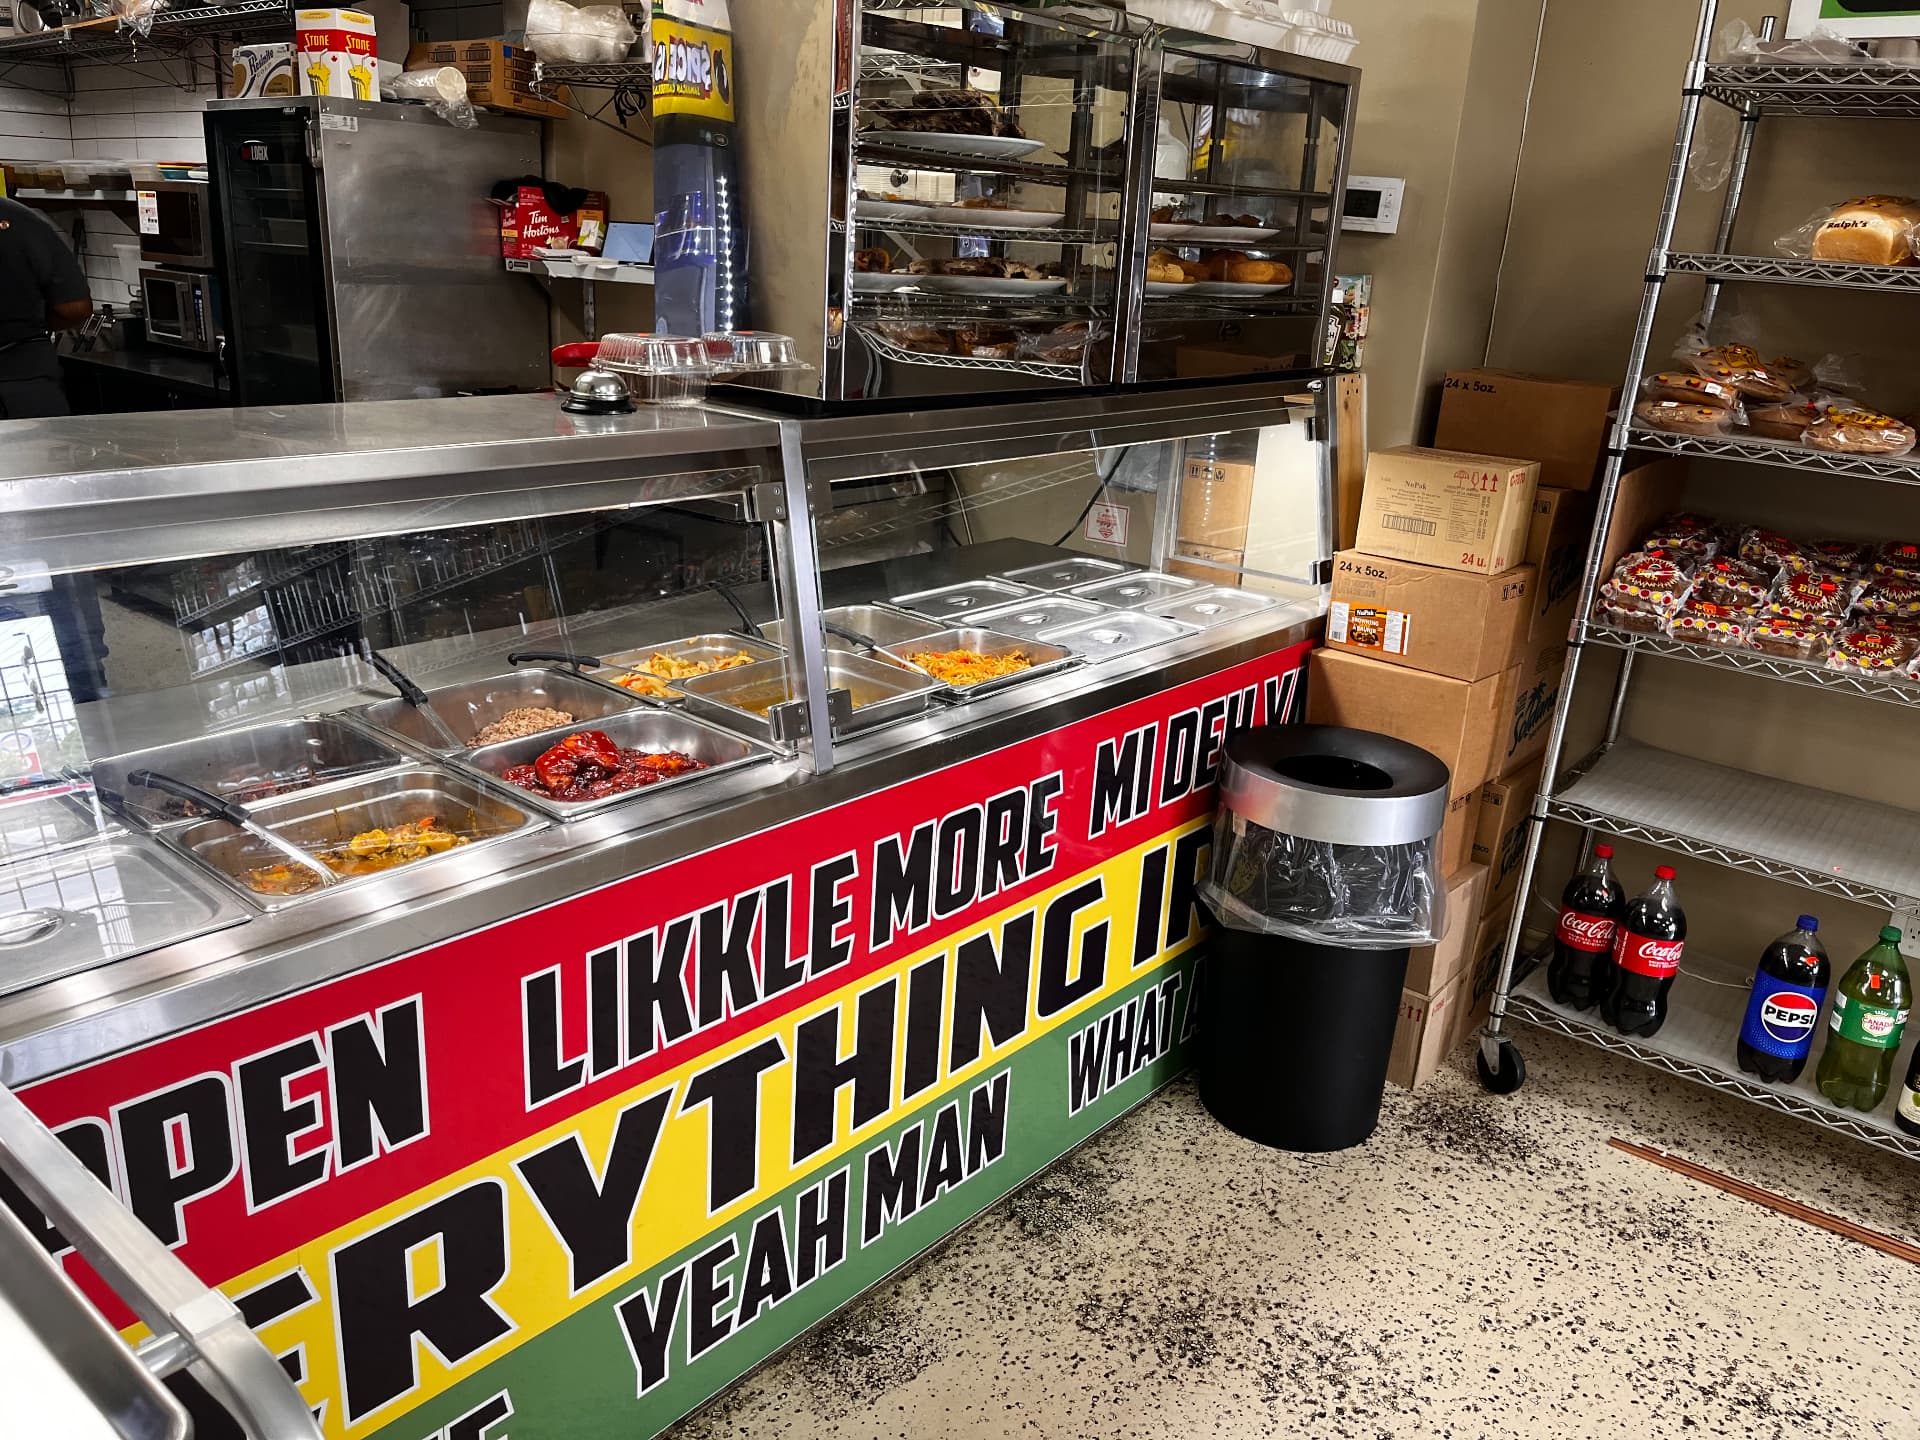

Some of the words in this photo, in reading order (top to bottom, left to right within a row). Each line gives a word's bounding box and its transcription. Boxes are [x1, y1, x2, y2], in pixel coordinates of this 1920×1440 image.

[304, 33, 330, 48] STONE
[345, 34, 371, 51] STONE
[528, 210, 548, 225] Tim
[1826, 220, 1868, 230] Ralph's
[523, 224, 561, 239] Hortons
[1445, 378, 1459, 389] 24
[1473, 381, 1497, 393] 5oz.
[1461, 553, 1474, 566] 24
[1477, 557, 1487, 568] u.
[1340, 561, 1353, 572] 24
[1356, 566, 1362, 574] x
[1365, 565, 1388, 580] 5oz.
[521, 849, 858, 1113] LIKKLE
[868, 769, 1063, 953] MORE
[1088, 720, 1159, 841] MI
[1765, 1005, 1815, 1025] PEPSI
[613, 1164, 850, 1399] YEAH
[861, 1066, 1012, 1250] MAN
[1067, 969, 1182, 1119] WHAT
